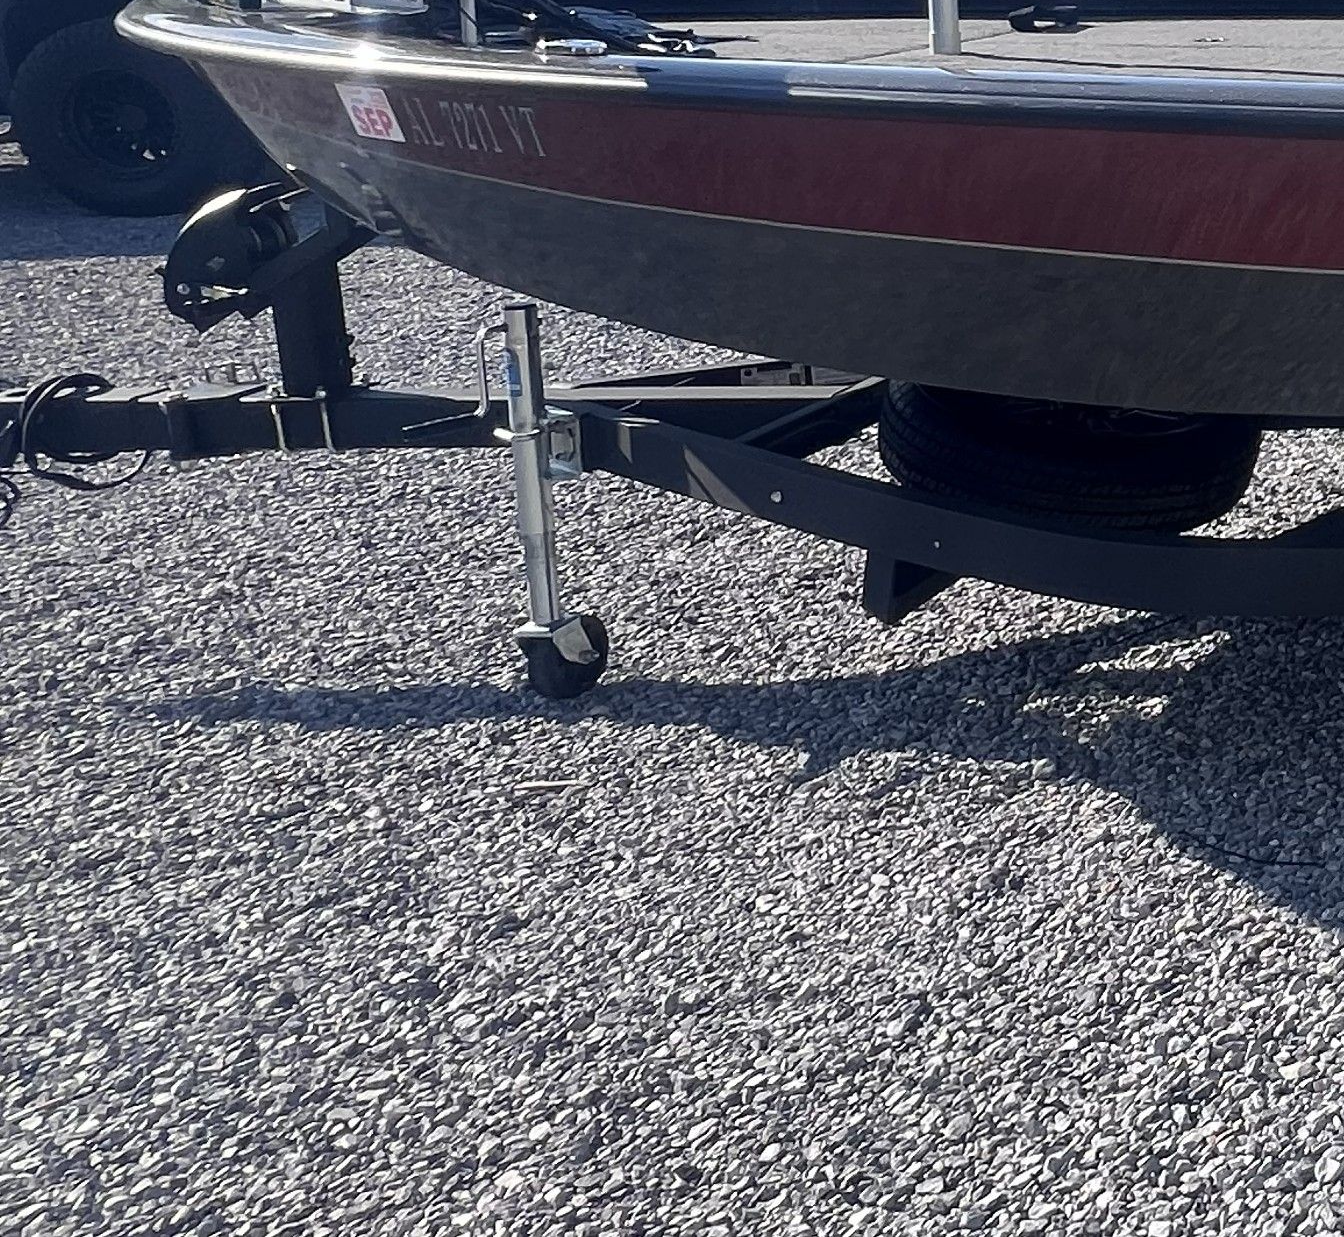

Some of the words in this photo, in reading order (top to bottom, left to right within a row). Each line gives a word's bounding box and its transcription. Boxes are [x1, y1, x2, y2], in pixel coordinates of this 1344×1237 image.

[350, 104, 394, 138] SEP
[401, 96, 446, 147] AL
[497, 104, 547, 157] VT
